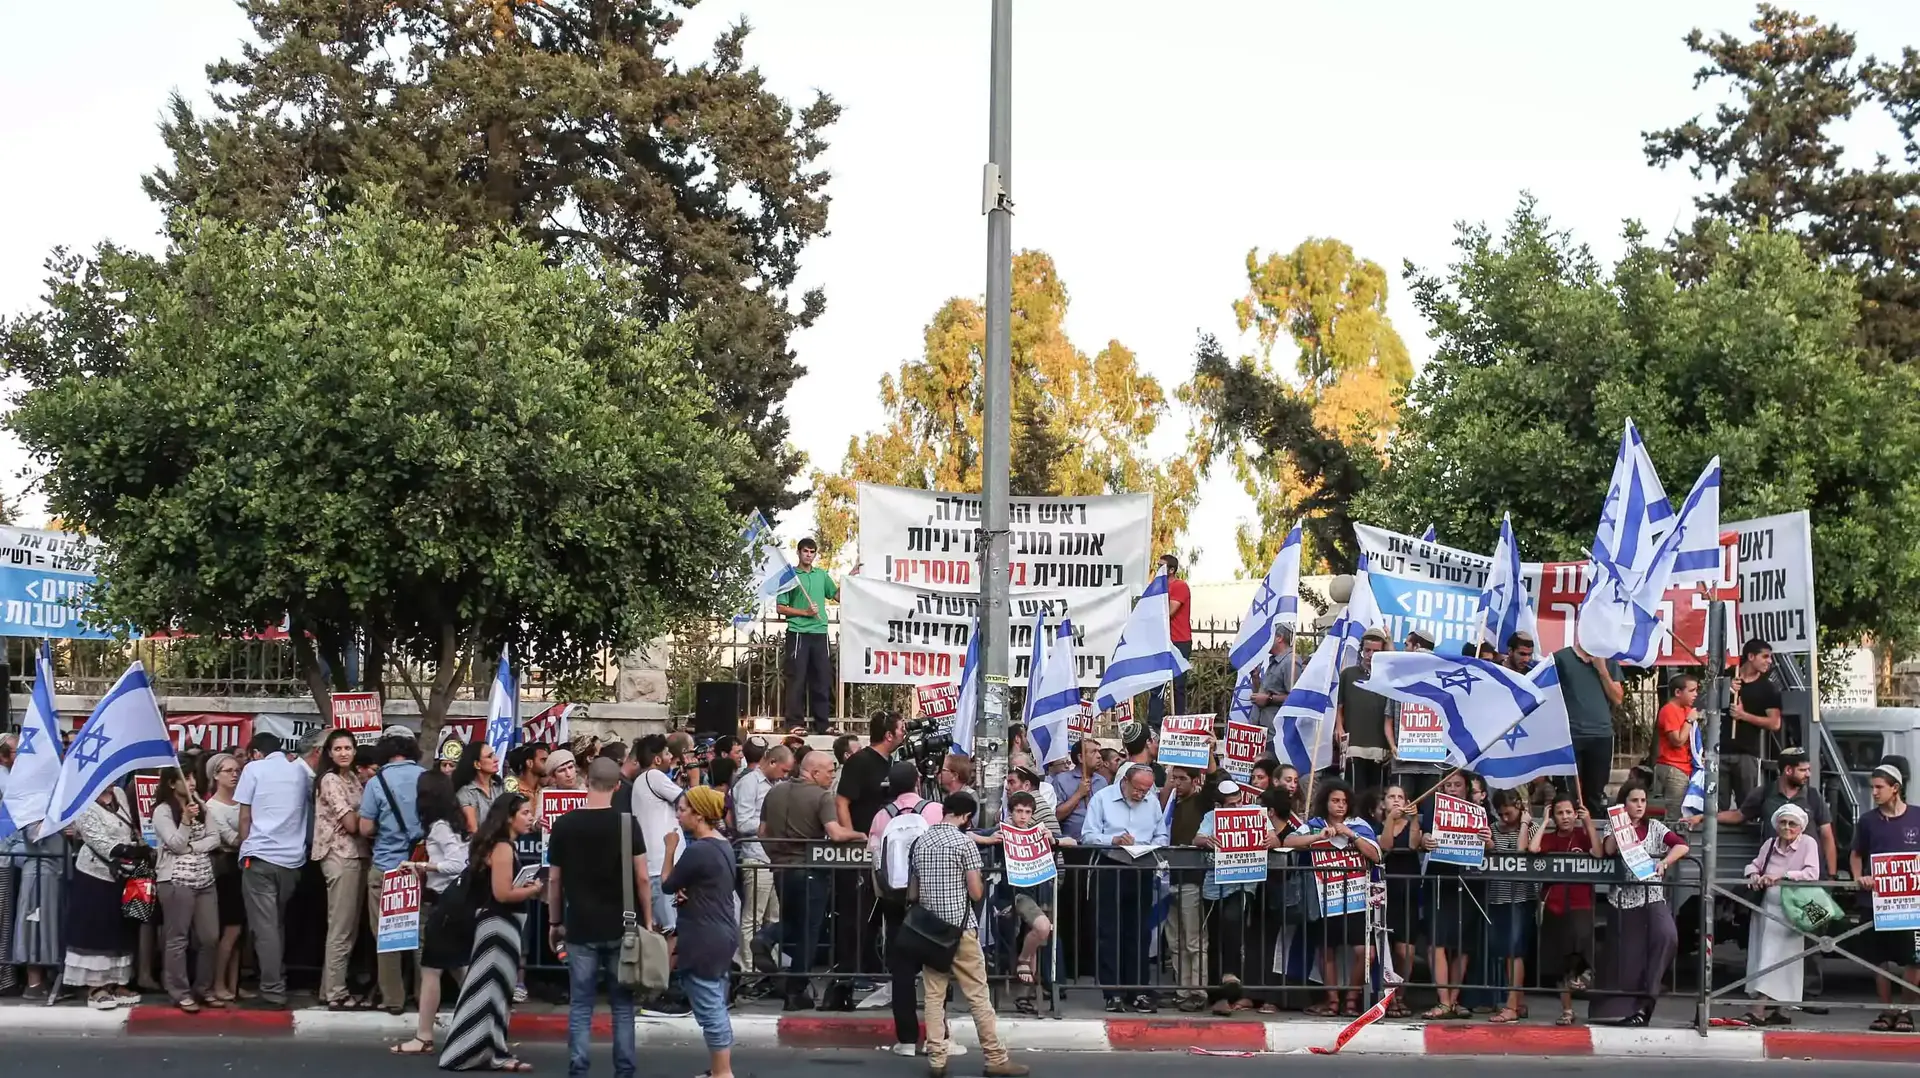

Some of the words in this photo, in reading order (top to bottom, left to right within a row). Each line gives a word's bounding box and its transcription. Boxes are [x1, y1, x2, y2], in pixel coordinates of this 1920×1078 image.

[1038, 503, 1087, 525] ראש
[18, 533, 42, 549] את
[1009, 531, 1052, 555] מובי
[1059, 532, 1105, 556] אתה
[1388, 536, 1414, 556] את
[35, 554, 45, 564] =
[1410, 563, 1421, 572] =
[885, 555, 970, 585] מוסרית!
[1033, 563, 1124, 587] ביטחונית
[1426, 562, 1473, 585] לטרור
[1750, 568, 1787, 602] אתה
[1020, 599, 1068, 617] ראש
[1415, 590, 1480, 624] בונים
[887, 620, 969, 647] מדיניות
[864, 647, 951, 677] מוסרית!
[919, 690, 931, 702] את
[932, 685, 955, 699] עוצרים
[335, 700, 347, 712] את
[350, 698, 377, 712] עוצרים
[921, 699, 948, 716] הטרור
[336, 713, 365, 729] הטרור
[368, 711, 380, 728] גל
[1168, 718, 1197, 730] הטרור
[1199, 718, 1210, 731] גל
[1403, 712, 1432, 728] הטרור
[1229, 728, 1239, 741] את
[1240, 730, 1263, 744] עוצרים
[1228, 741, 1250, 758] הטרור
[545, 798, 558, 811] את
[1438, 798, 1450, 809] את
[1453, 801, 1482, 815] עוצרים
[1218, 816, 1230, 830] את
[1233, 814, 1263, 829] עוצרים
[1437, 810, 1468, 828] הטרור
[1472, 814, 1484, 829] גל
[1015, 828, 1043, 844] עוצרים
[1218, 830, 1249, 848] הטרור
[1252, 829, 1264, 846] גל
[812, 846, 873, 863] POLICE
[1005, 840, 1033, 858] הטרור
[1034, 838, 1047, 855] גל
[1473, 856, 1528, 873] OLICE
[1552, 858, 1616, 873] משטרה
[1874, 861, 1888, 875] את
[1874, 875, 1907, 893] הטרור
[383, 891, 404, 912] הטרור
[406, 888, 418, 908] גל
